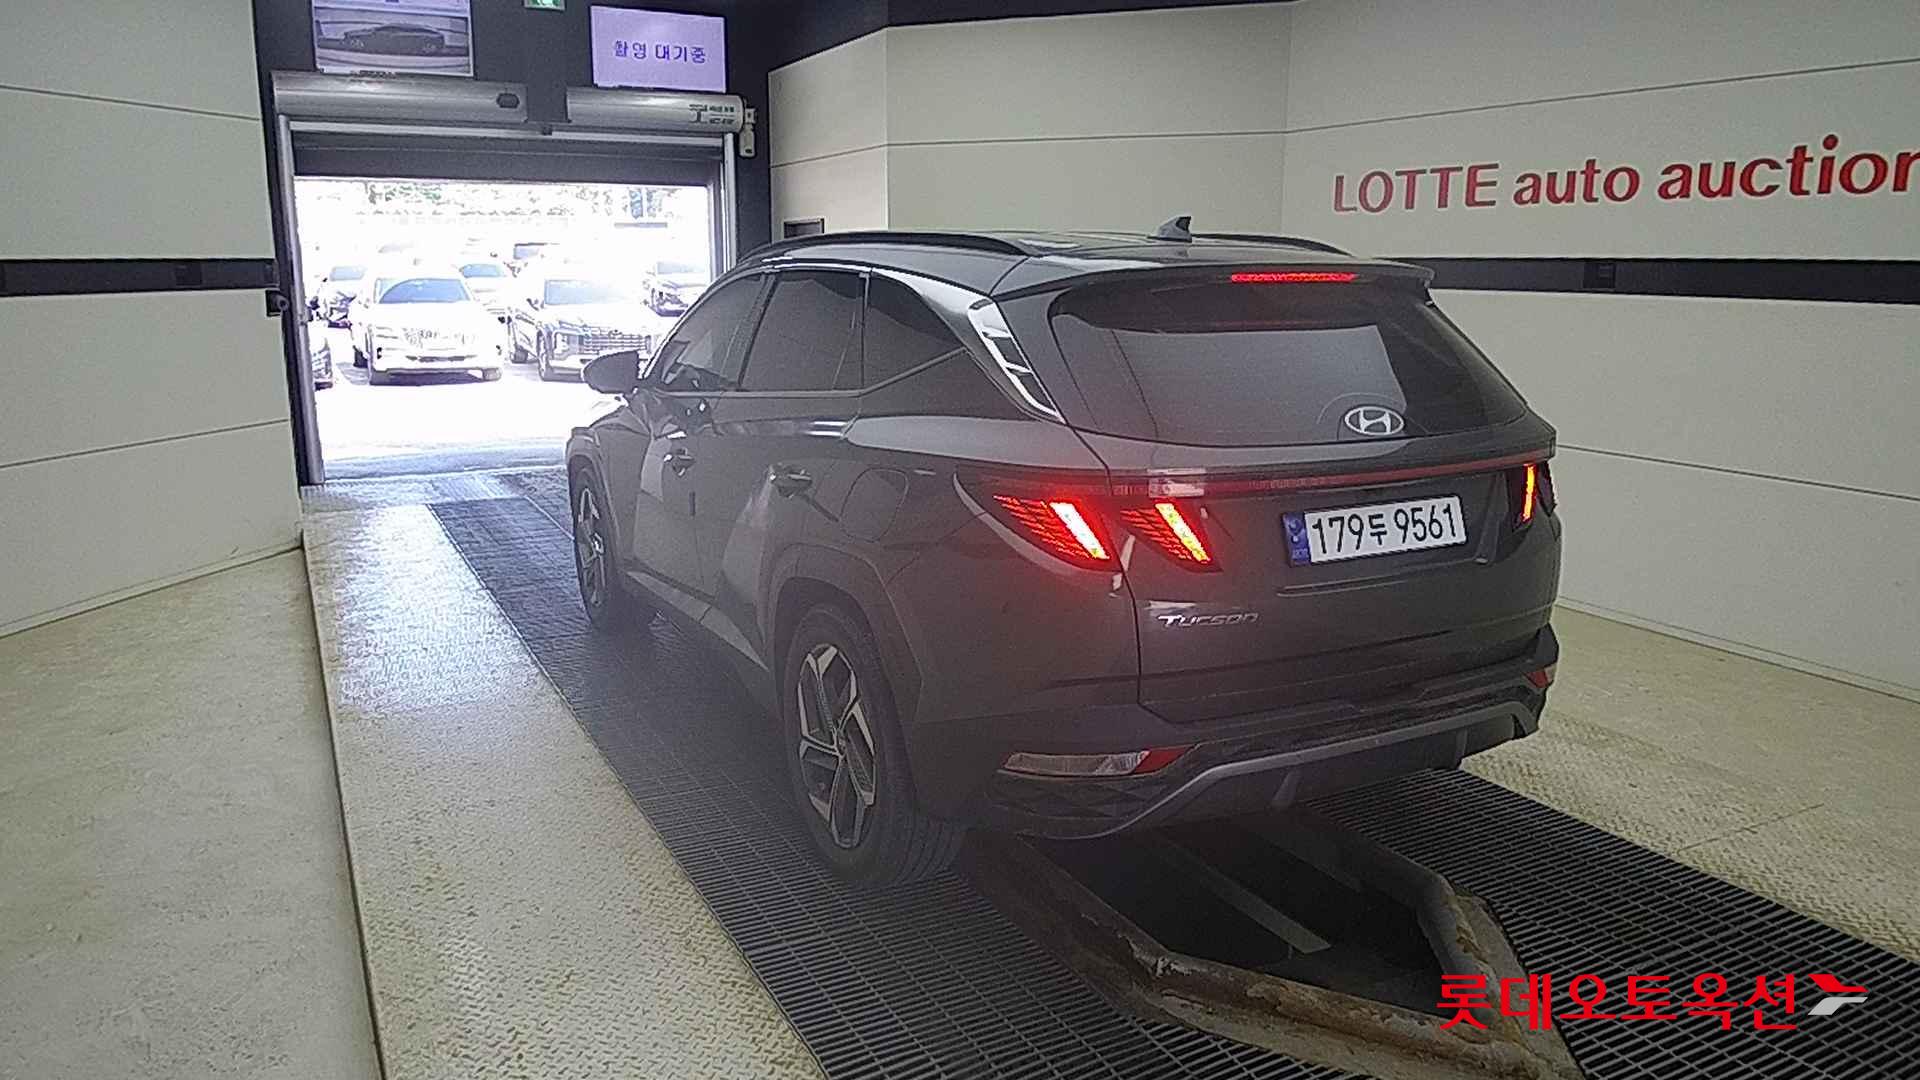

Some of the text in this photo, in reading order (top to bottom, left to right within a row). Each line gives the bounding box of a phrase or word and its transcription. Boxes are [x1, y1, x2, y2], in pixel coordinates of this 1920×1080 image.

[655, 44, 706, 63] 대기중
[1334, 163, 1500, 213] LOTTE
[1513, 159, 1640, 205] auto
